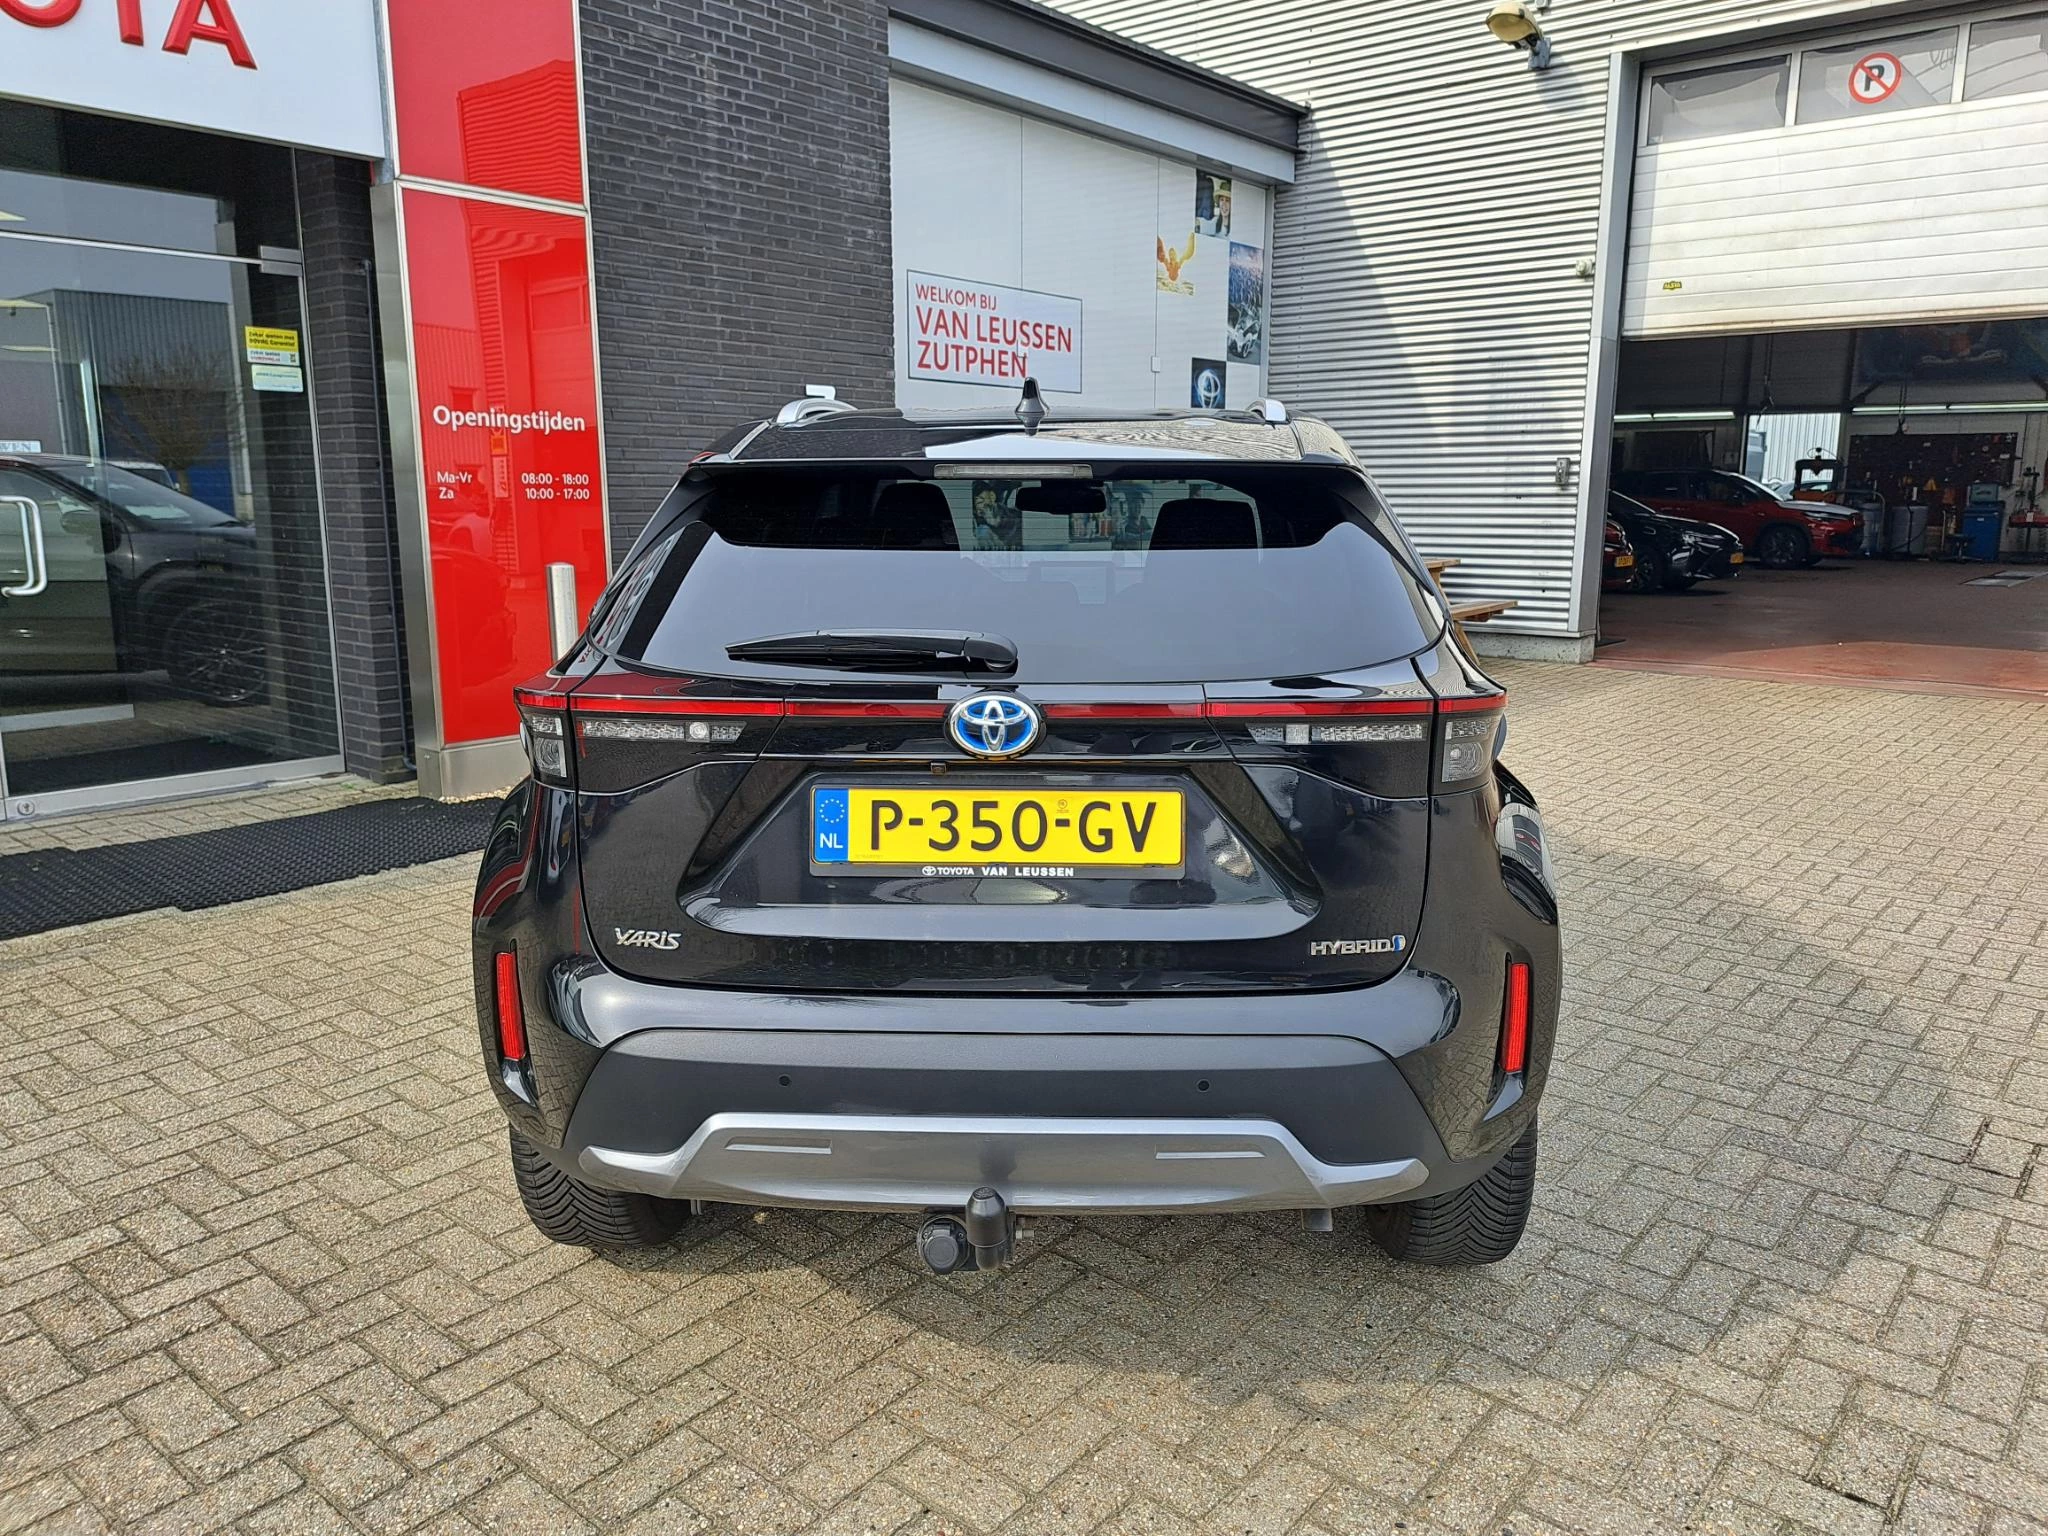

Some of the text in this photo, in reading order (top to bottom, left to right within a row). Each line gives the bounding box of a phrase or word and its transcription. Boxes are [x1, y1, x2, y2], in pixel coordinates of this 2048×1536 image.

[915, 283, 997, 311] WELKOM BIJ
[915, 305, 1072, 353] VAN LEUSSEN
[917, 340, 1028, 378] ZUTPHEN
[432, 405, 586, 435] Openingstijden
[436, 471, 473, 484] Ma-Vr
[521, 472, 553, 485] 08:00
[562, 473, 589, 485] 18:00
[439, 487, 455, 500] Za
[525, 487, 554, 500] 10:00
[564, 488, 590, 500] 17:00
[870, 799, 1157, 853] P-350-GV
[819, 832, 844, 849] NL
[937, 866, 1075, 877] TOYOTA VAN LEUSSEN
[614, 927, 682, 950] YARIS
[1310, 938, 1394, 956] HYBRID
